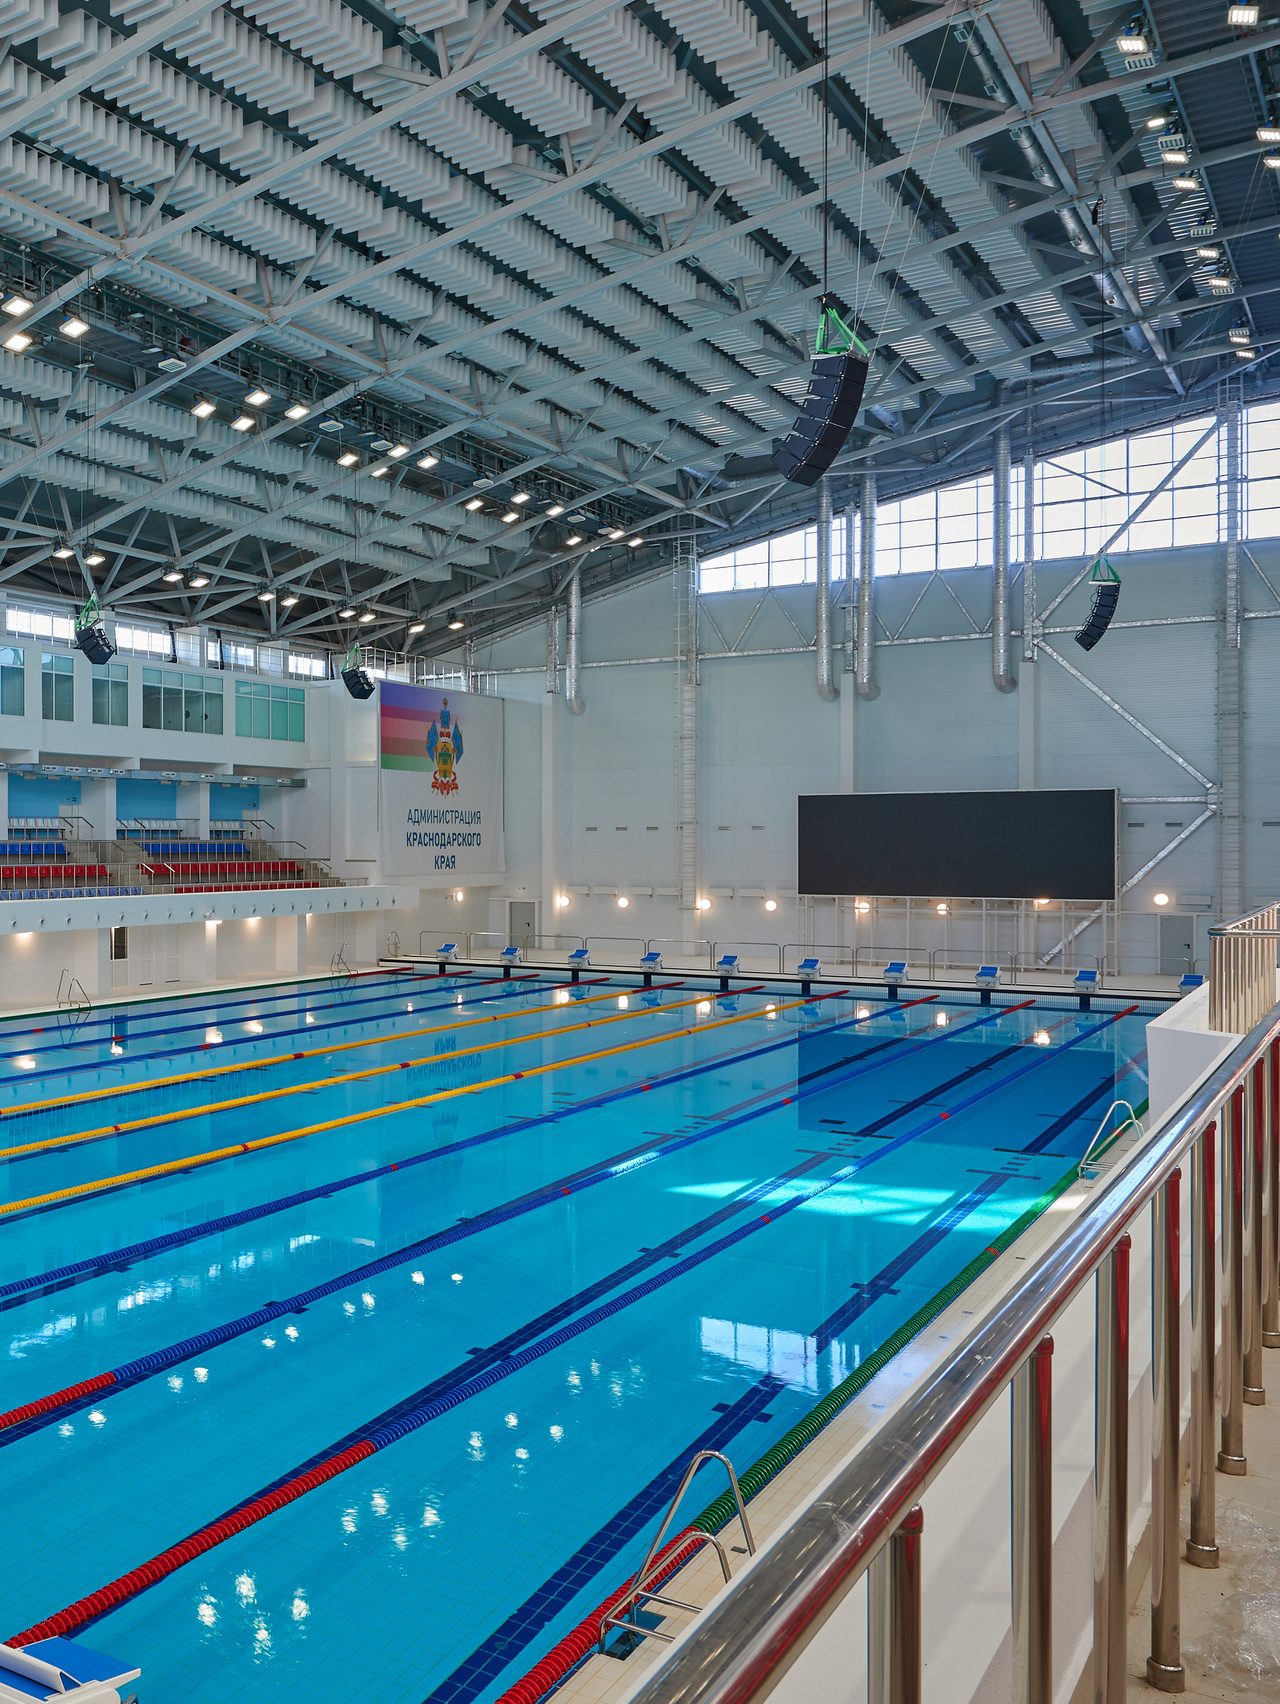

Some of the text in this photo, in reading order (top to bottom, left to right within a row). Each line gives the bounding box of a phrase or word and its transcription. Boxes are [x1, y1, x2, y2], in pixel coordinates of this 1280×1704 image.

[406, 808, 482, 827] АДМИНИСТРАЦИЯ
[406, 832, 482, 850] КРАСНОДАРСКОГО
[434, 855, 456, 870] КРАЯ
